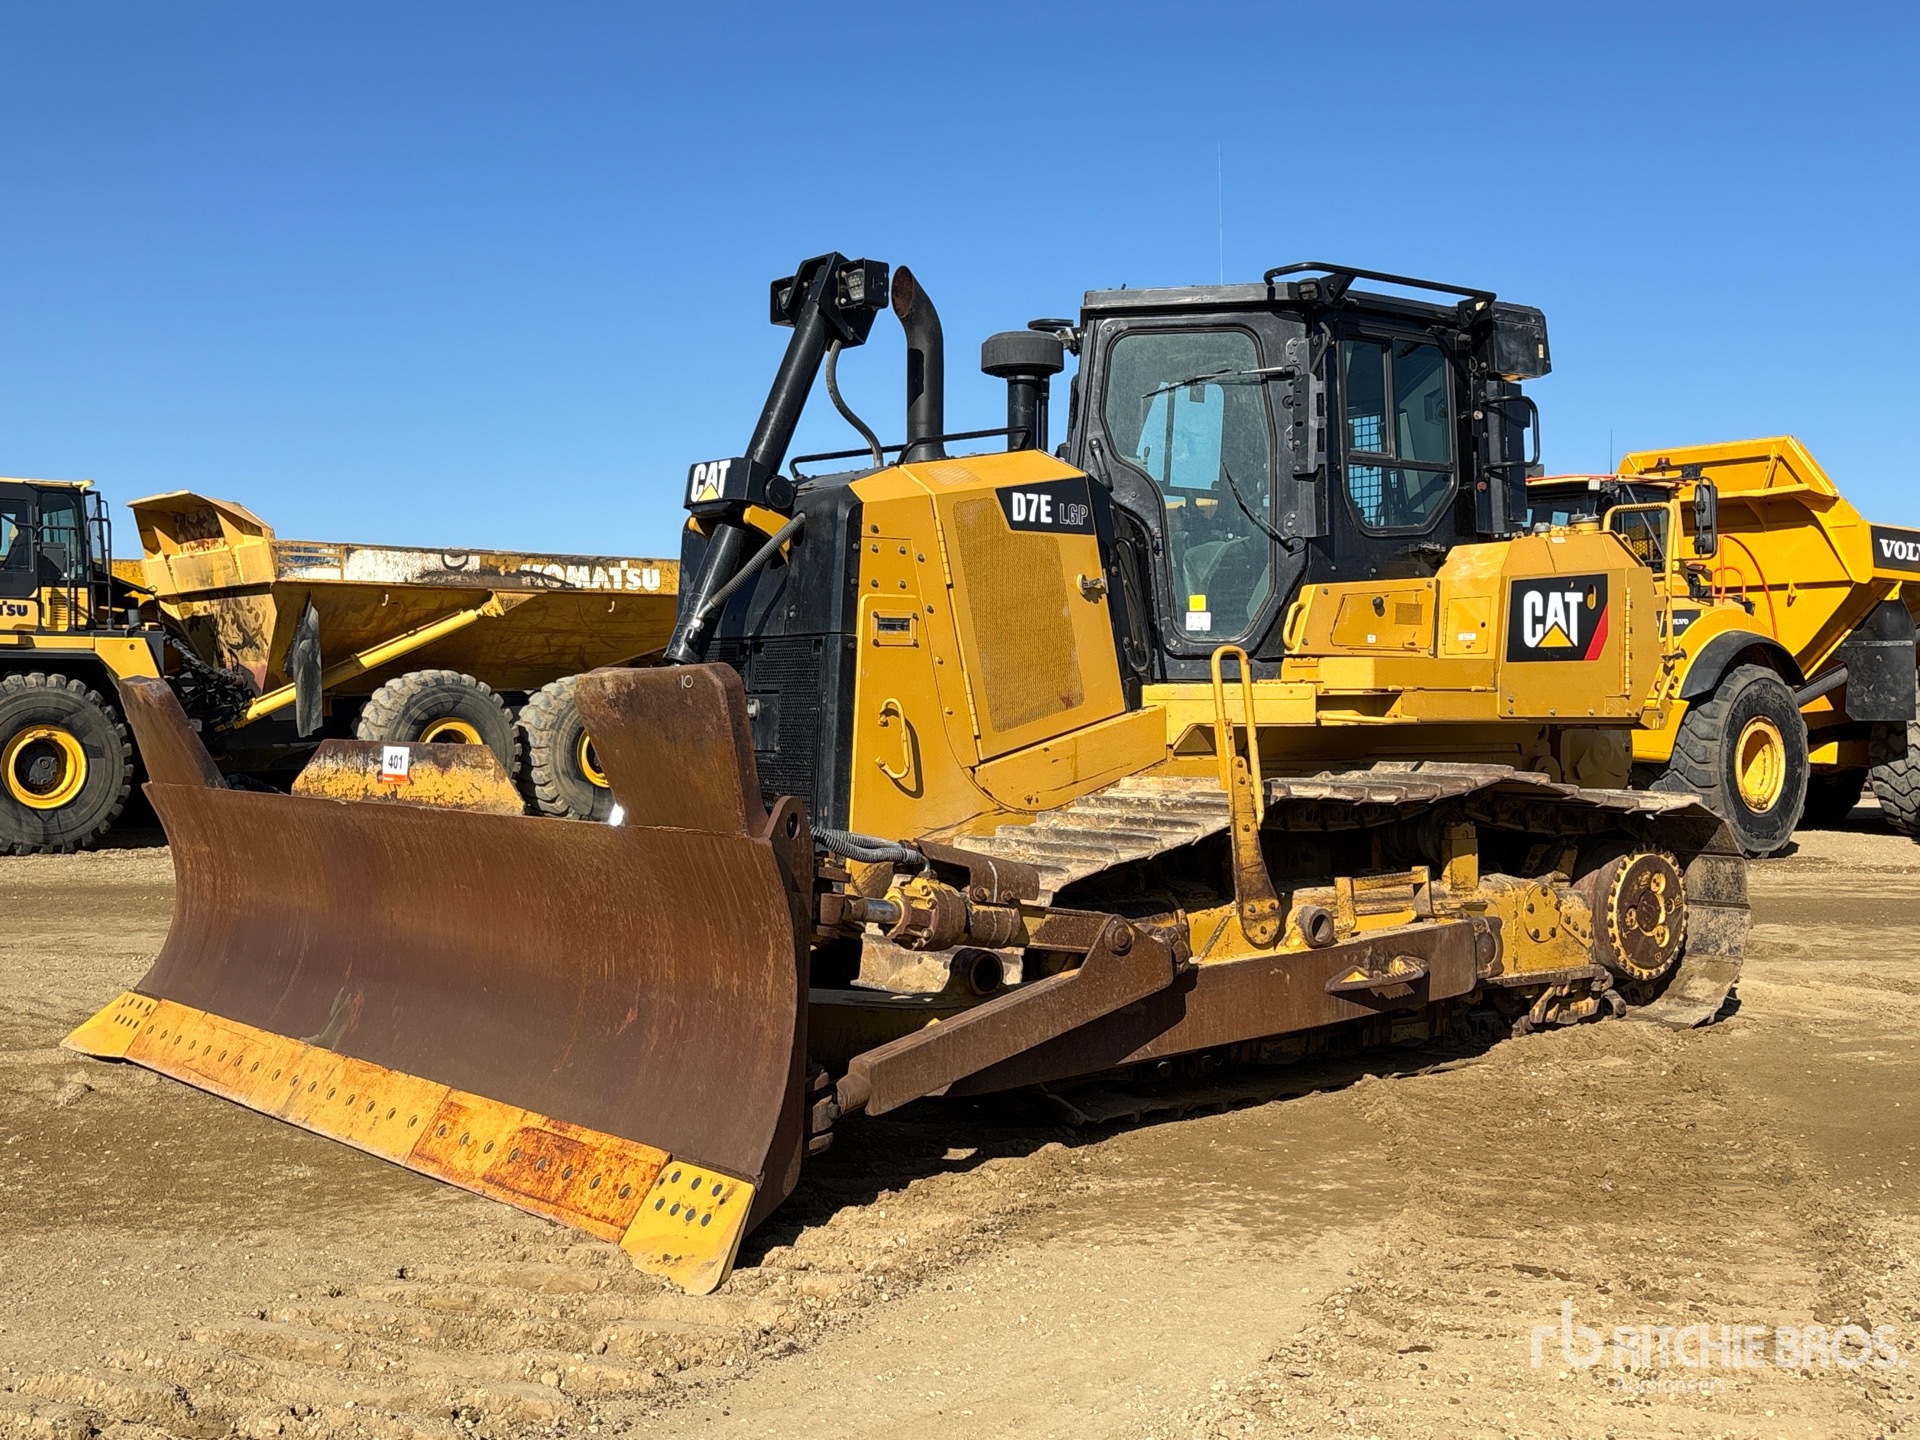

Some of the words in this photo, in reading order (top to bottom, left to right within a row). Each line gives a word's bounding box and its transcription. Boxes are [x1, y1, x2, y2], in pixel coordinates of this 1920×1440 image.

[691, 460, 731, 502] CAT
[1012, 492, 1053, 524] D7E
[1059, 503, 1089, 526] LGP
[1523, 590, 1584, 648] CAT
[388, 754, 403, 770] 401
